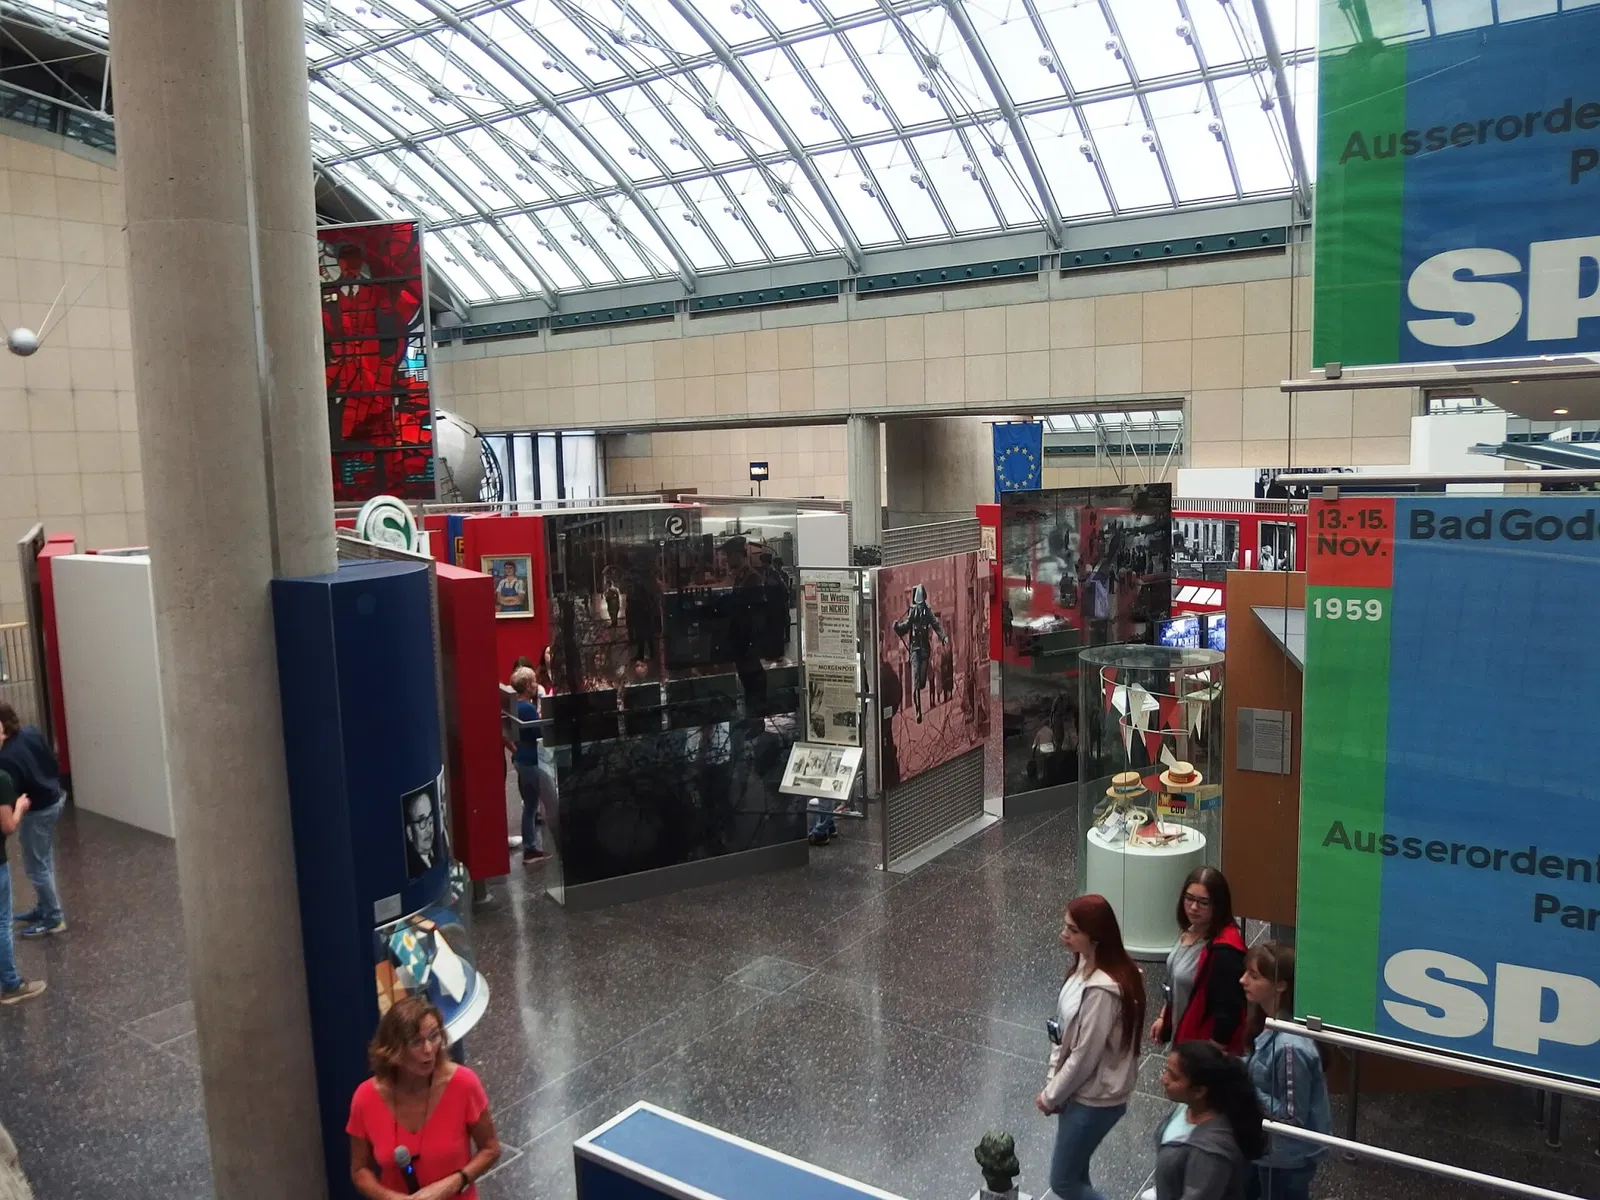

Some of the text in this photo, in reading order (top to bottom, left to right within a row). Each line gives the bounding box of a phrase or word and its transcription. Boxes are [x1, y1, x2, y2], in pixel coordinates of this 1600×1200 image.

[1570, 148, 1600, 185] P
[1406, 235, 1600, 348] SP
[1409, 508, 1600, 542] Bad God
[1313, 597, 1383, 622] 1959
[818, 664, 855, 672] MORGENPOST
[1382, 947, 1600, 1056] SP
